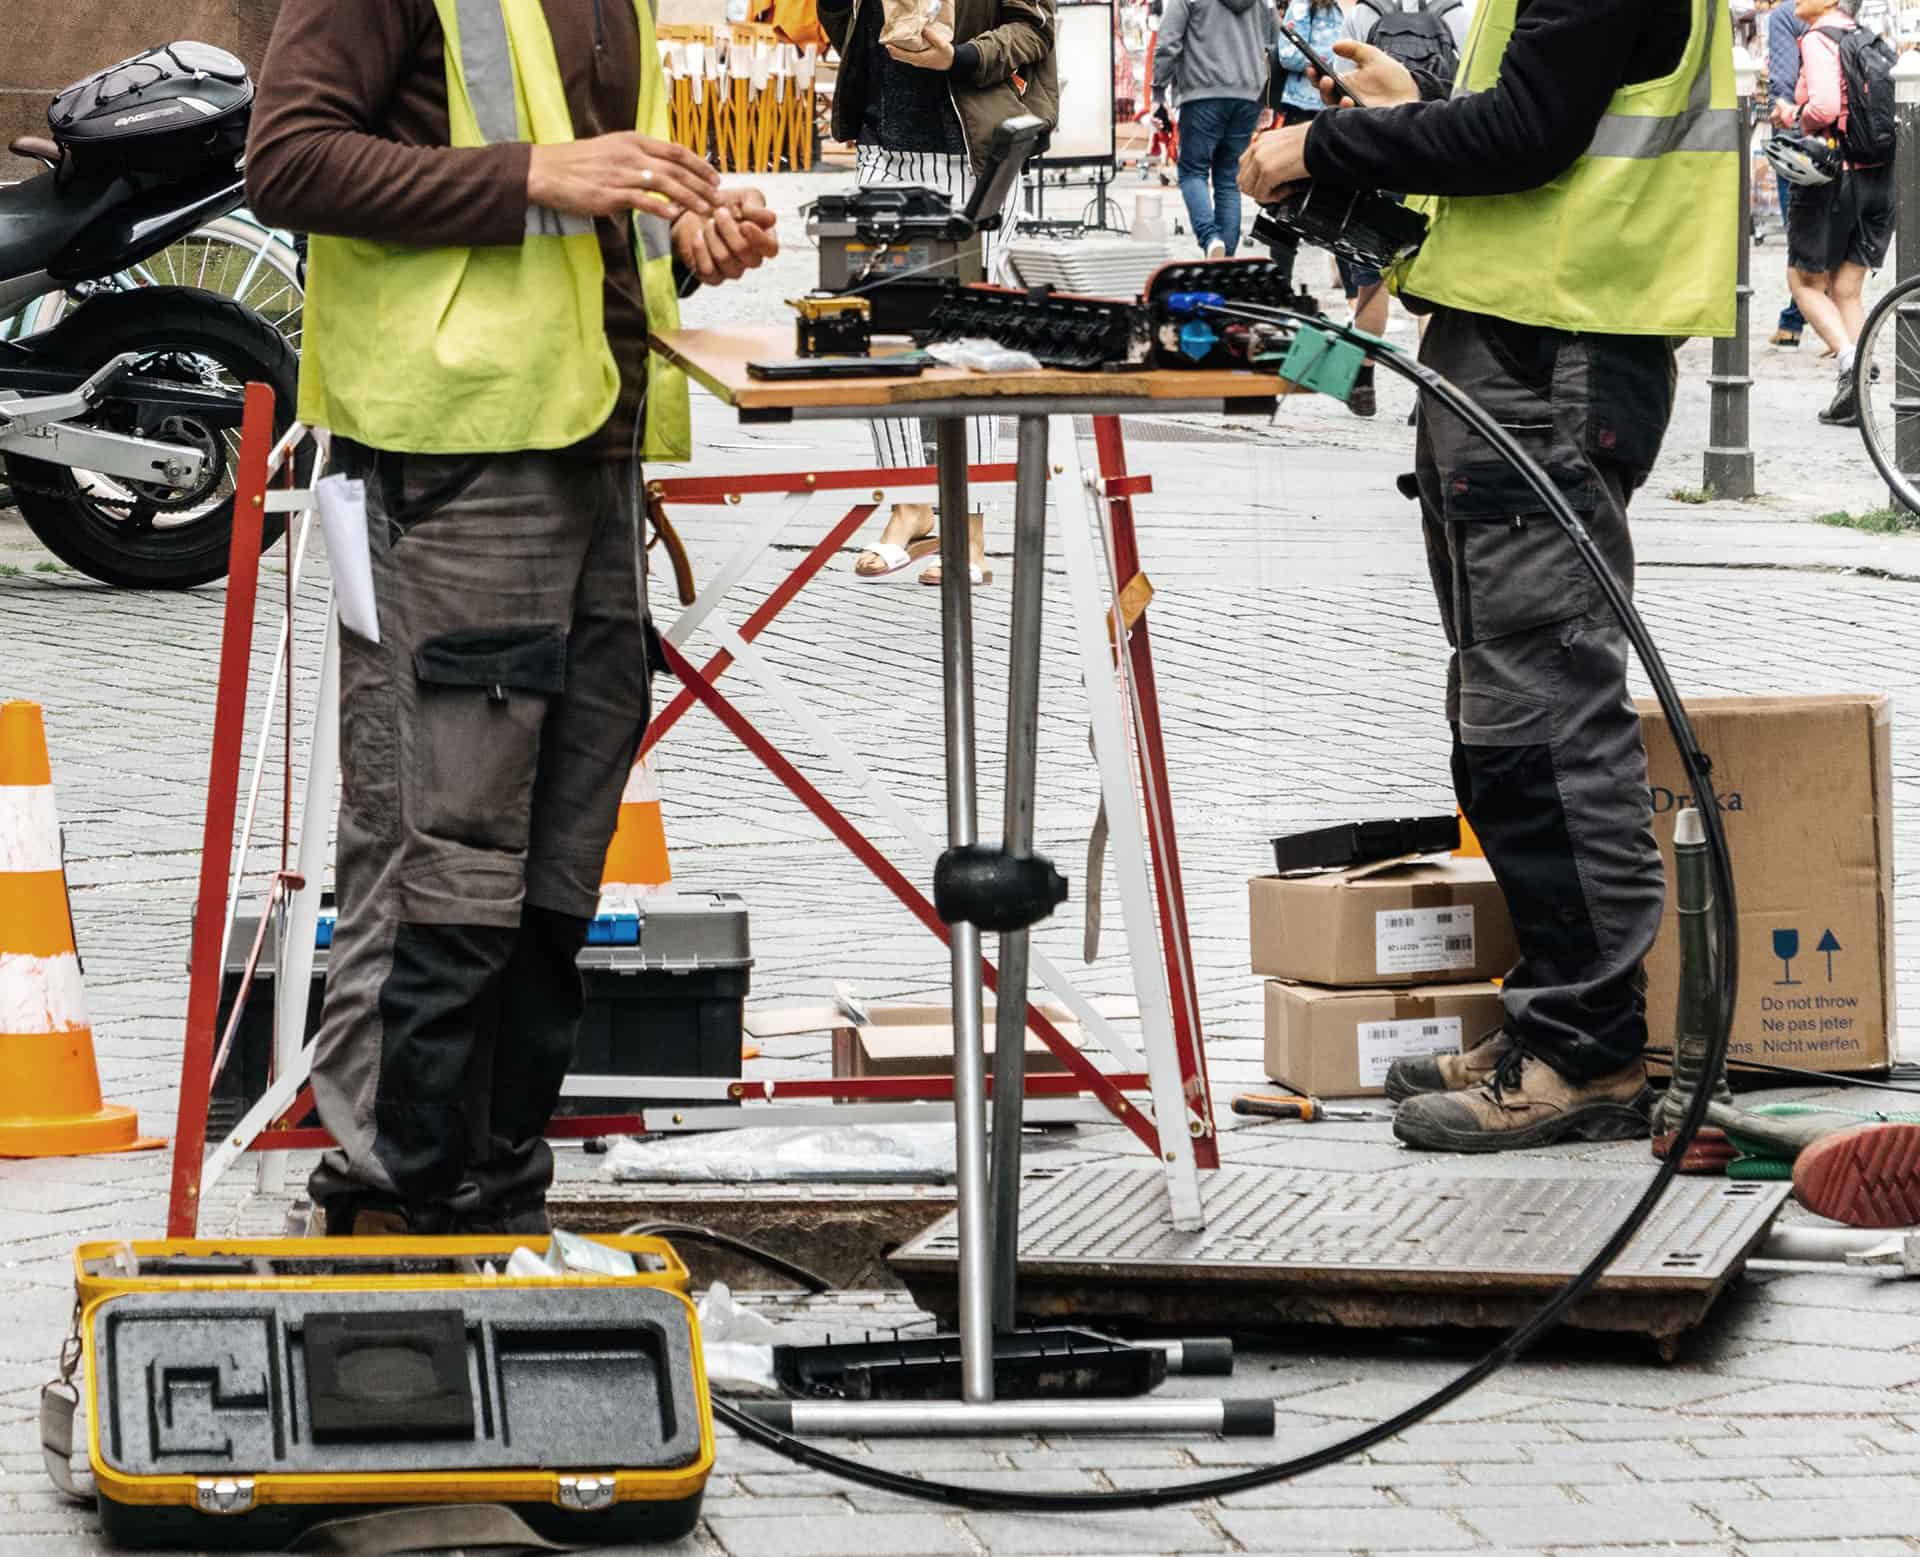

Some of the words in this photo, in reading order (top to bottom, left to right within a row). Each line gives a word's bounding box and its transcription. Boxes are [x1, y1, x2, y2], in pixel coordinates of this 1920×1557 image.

[1650, 787, 1743, 813] Drka
[1761, 997, 1784, 1011] Do
[1785, 996, 1811, 1010] not
[1815, 995, 1858, 1009] throw
[1762, 1018, 1784, 1032] Ne
[1788, 1020, 1816, 1034] pas
[1818, 1017, 1854, 1032] jeter
[1763, 1039, 1803, 1053] Nicht
[1806, 1037, 1860, 1052] werfen
